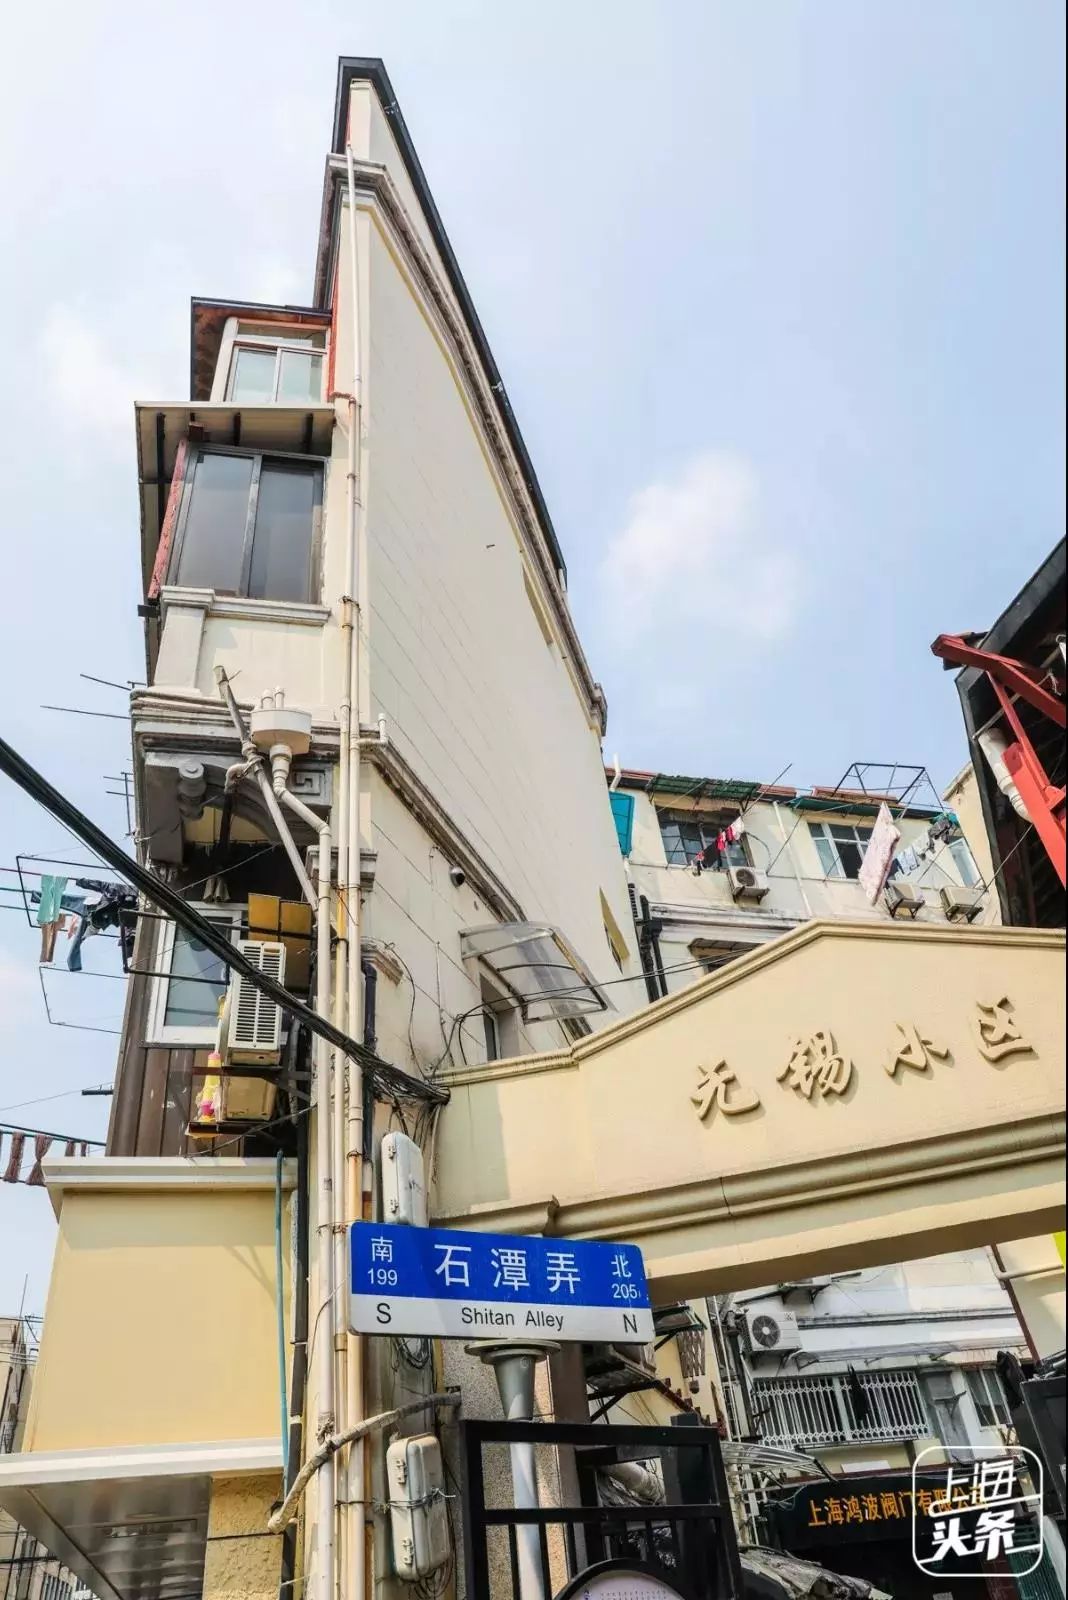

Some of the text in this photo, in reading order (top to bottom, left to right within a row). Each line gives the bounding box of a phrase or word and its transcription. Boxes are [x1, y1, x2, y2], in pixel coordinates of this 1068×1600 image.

[690, 996, 1033, 1120] 无锡小区
[367, 1268, 638, 1299] 199 205
[371, 1236, 632, 1295] 南 石潭弄 北
[376, 1303, 638, 1333] S Shitan Alley N
